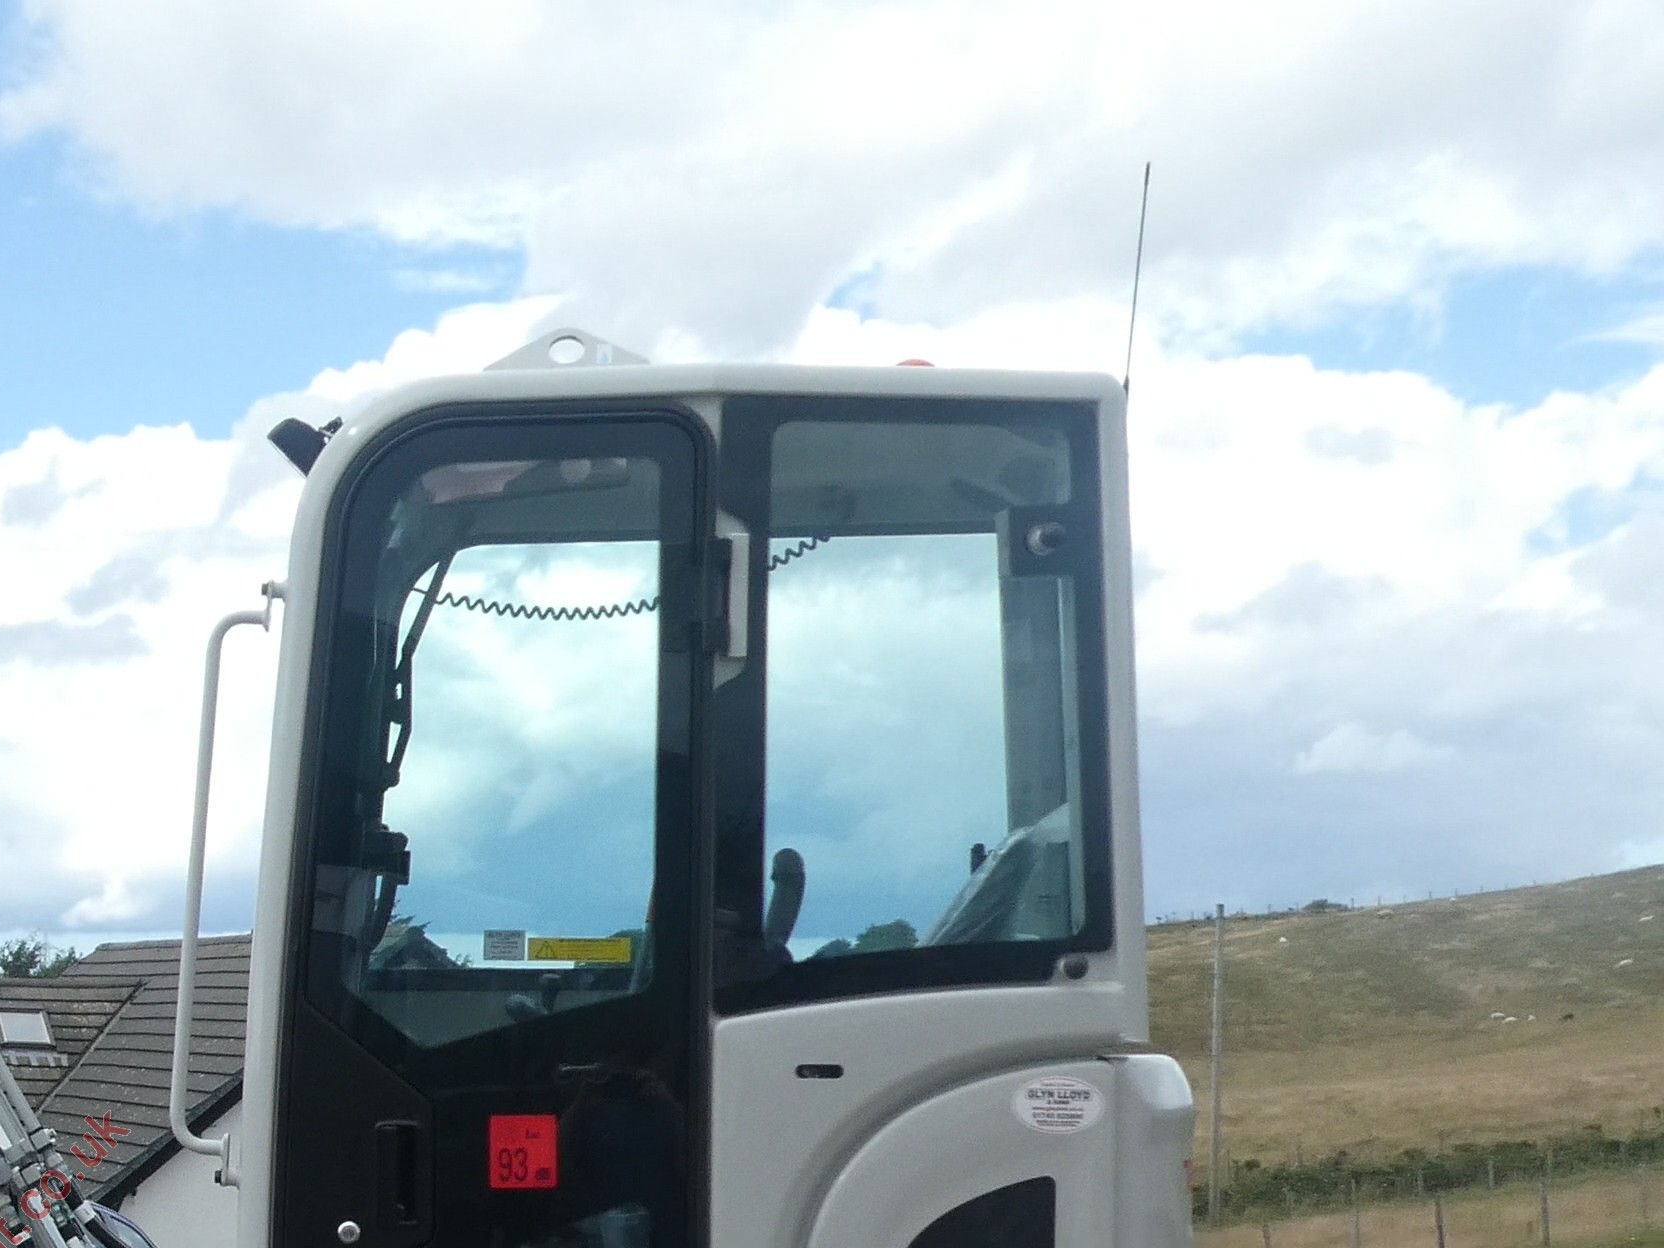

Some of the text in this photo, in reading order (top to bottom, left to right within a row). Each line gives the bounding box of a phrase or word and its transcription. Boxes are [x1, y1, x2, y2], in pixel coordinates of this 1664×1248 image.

[1027, 1089, 1091, 1100] GLYN LLOYD
[498, 1147, 529, 1182] 93
